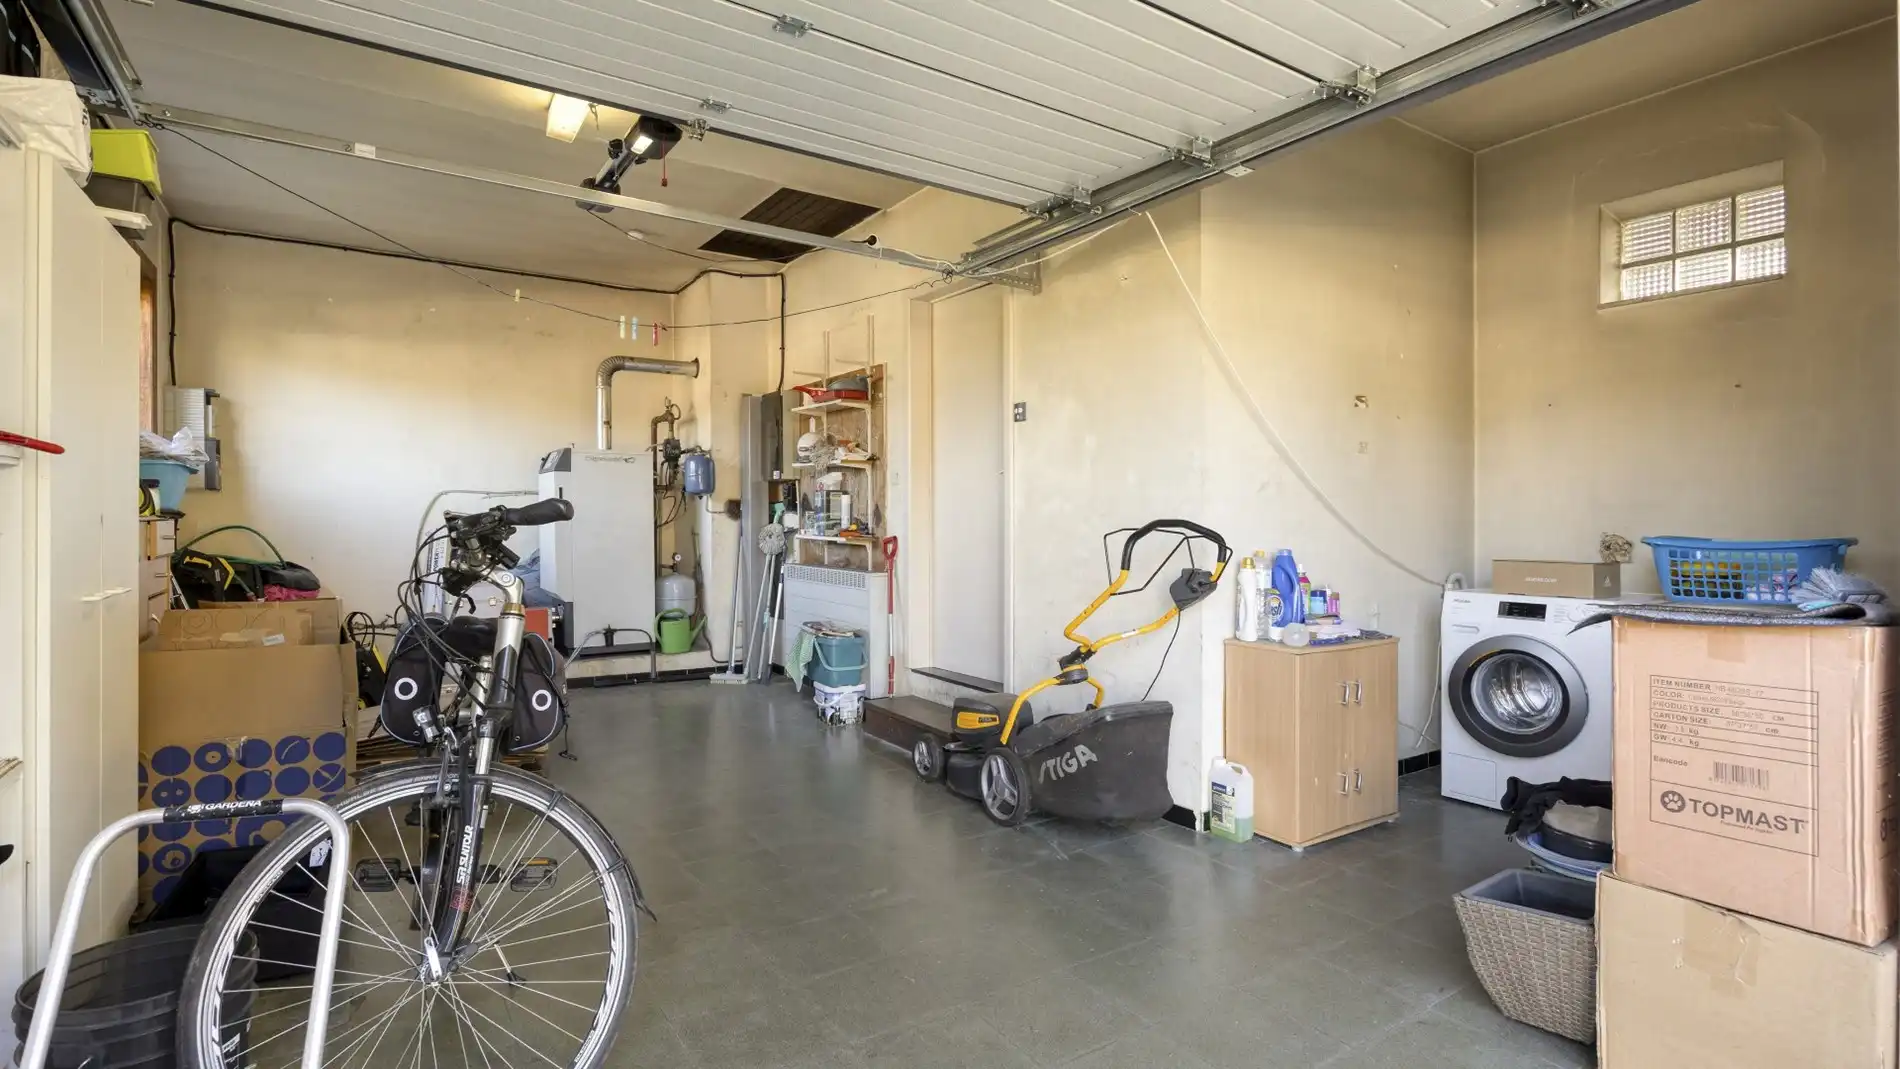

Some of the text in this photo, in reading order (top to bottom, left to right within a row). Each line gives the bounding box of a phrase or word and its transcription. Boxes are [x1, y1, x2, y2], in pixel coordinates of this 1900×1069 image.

[1653, 701, 1699, 712] PRODUCTS
[1653, 712, 1687, 722] CARTON
[1039, 744, 1098, 784] STIGA
[205, 800, 262, 811] GARDENA
[1688, 798, 1805, 834] TOPMAST
[459, 825, 473, 866] SUNTOUR
